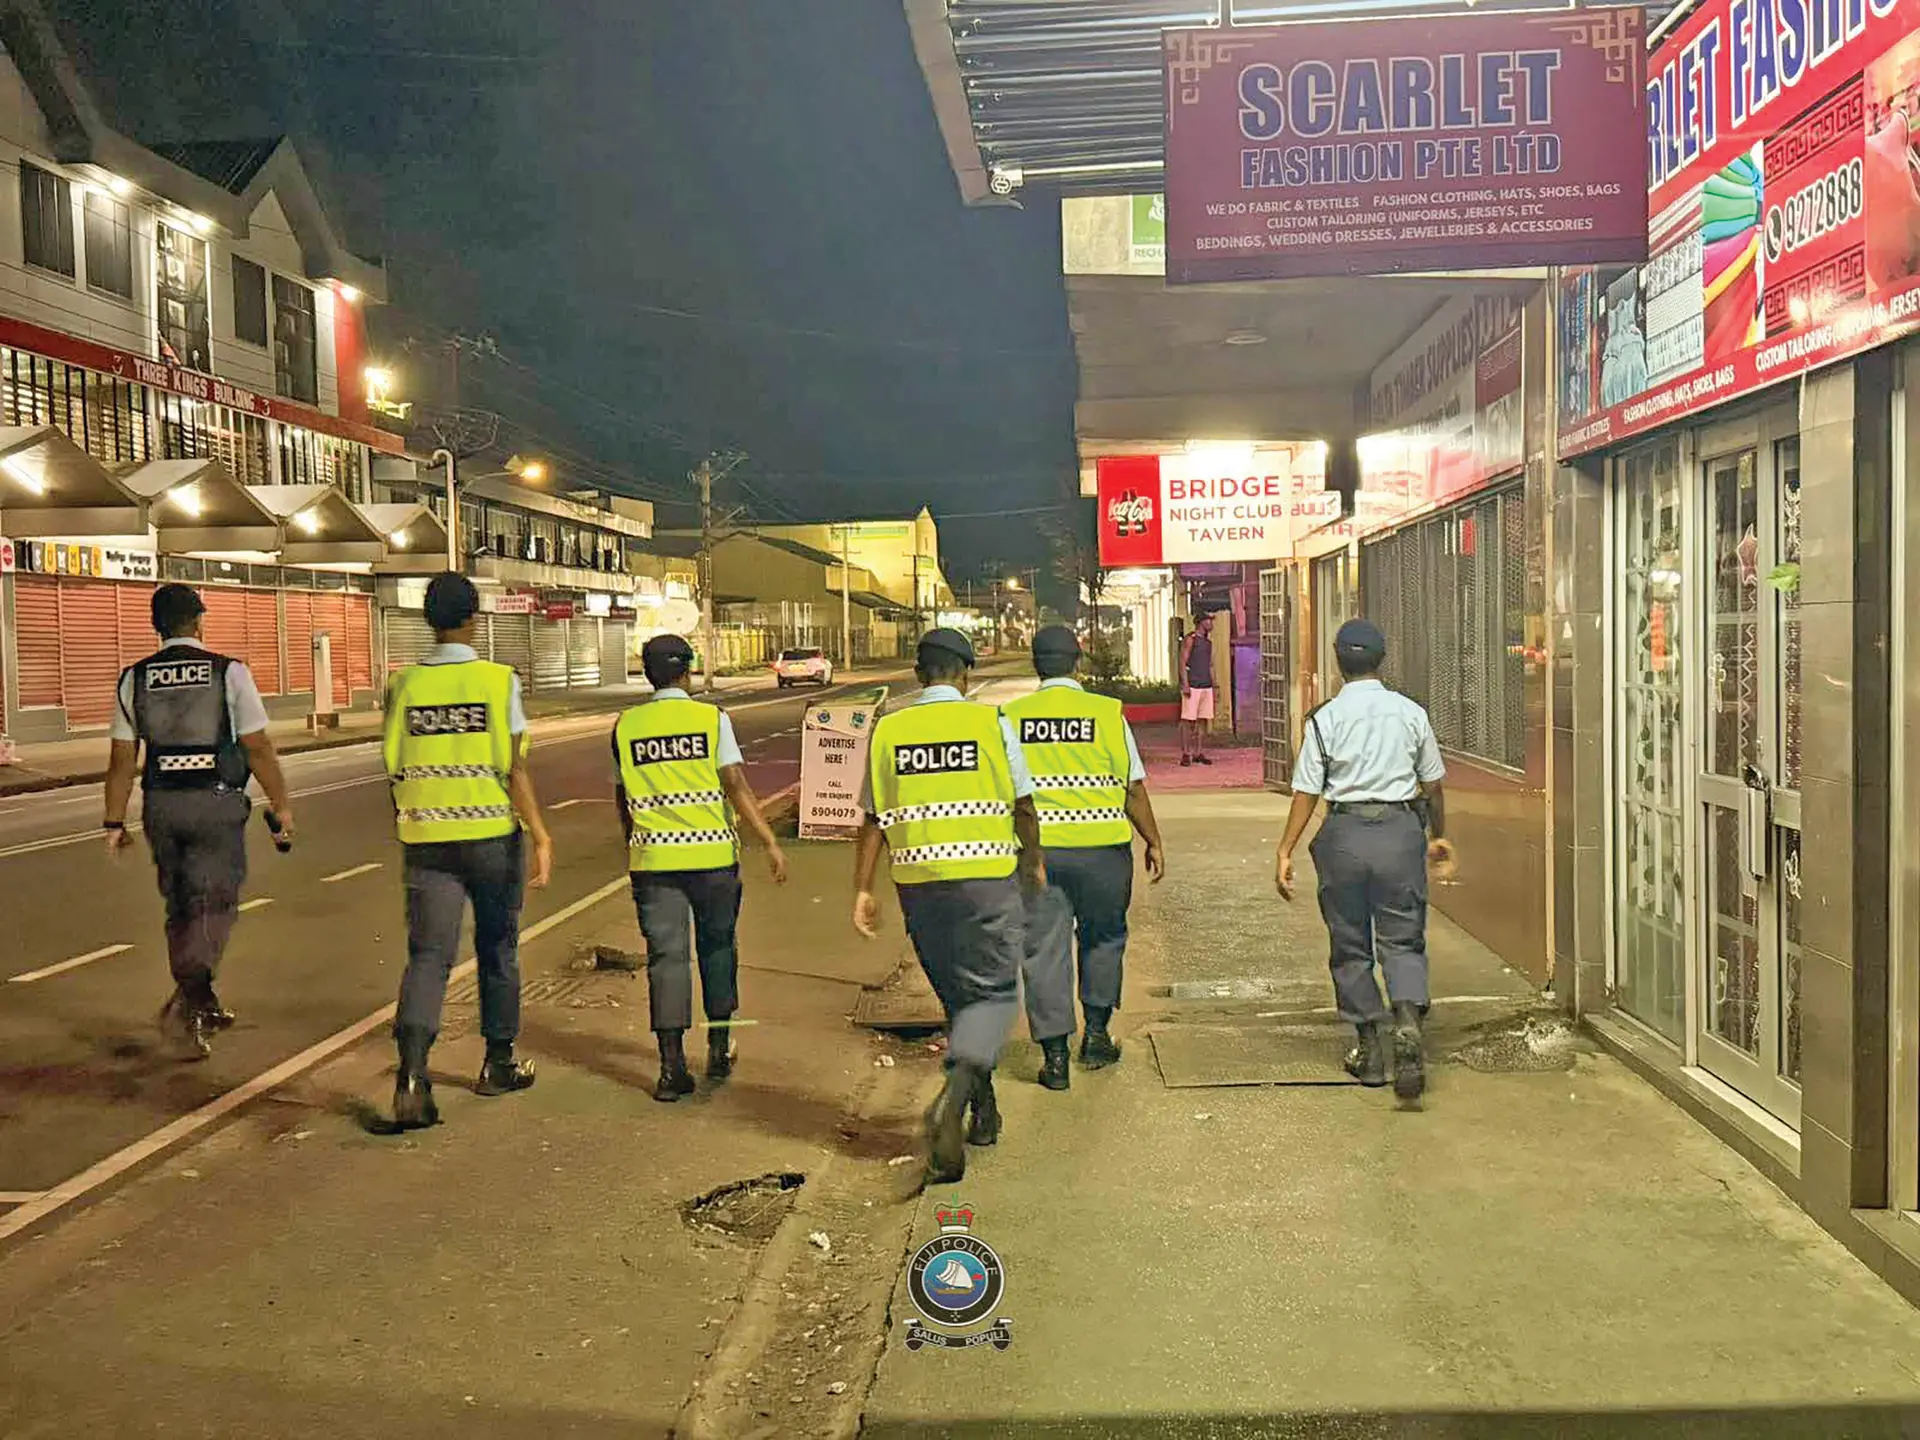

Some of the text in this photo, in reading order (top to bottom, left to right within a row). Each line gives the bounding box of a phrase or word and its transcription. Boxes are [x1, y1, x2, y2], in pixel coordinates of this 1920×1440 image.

[1238, 49, 1561, 140] SCARLET
[1241, 132, 1562, 188] FASHION PTE LTD
[1206, 184, 1621, 216] WE DO FABRIC & TEXTILES FASHION CLOTHING, HATS, SHOES, BAGS
[1785, 158, 1863, 252] 9272888
[1267, 215, 1318, 229] CUSTOM
[1320, 212, 1385, 227] TAILORING
[1464, 205, 1518, 219] JERSEYS,
[1521, 204, 1545, 215] ETC
[1196, 218, 1593, 250] BEDDINGS, WEDDING DRESSES, JEWELLERIES & ACCESSORIES
[1756, 344, 1787, 372] CUSTOM
[1788, 325, 1833, 358] TAILORING
[133, 358, 169, 387] THREE
[173, 368, 208, 398] KINGS
[214, 382, 255, 411] BUILDING
[1169, 475, 1280, 500] BRIDGE
[1169, 504, 1282, 522] NIGHT CLUB
[1188, 526, 1264, 542] TAVERN
[149, 665, 209, 686] POLICE
[409, 707, 485, 731] POLICE
[1024, 719, 1091, 741] POLICE
[635, 736, 705, 762] POLICE
[818, 738, 855, 749] ADVERTISE
[825, 753, 842, 764] HERE
[898, 745, 975, 771] POLICE
[811, 806, 856, 818] 8904079
